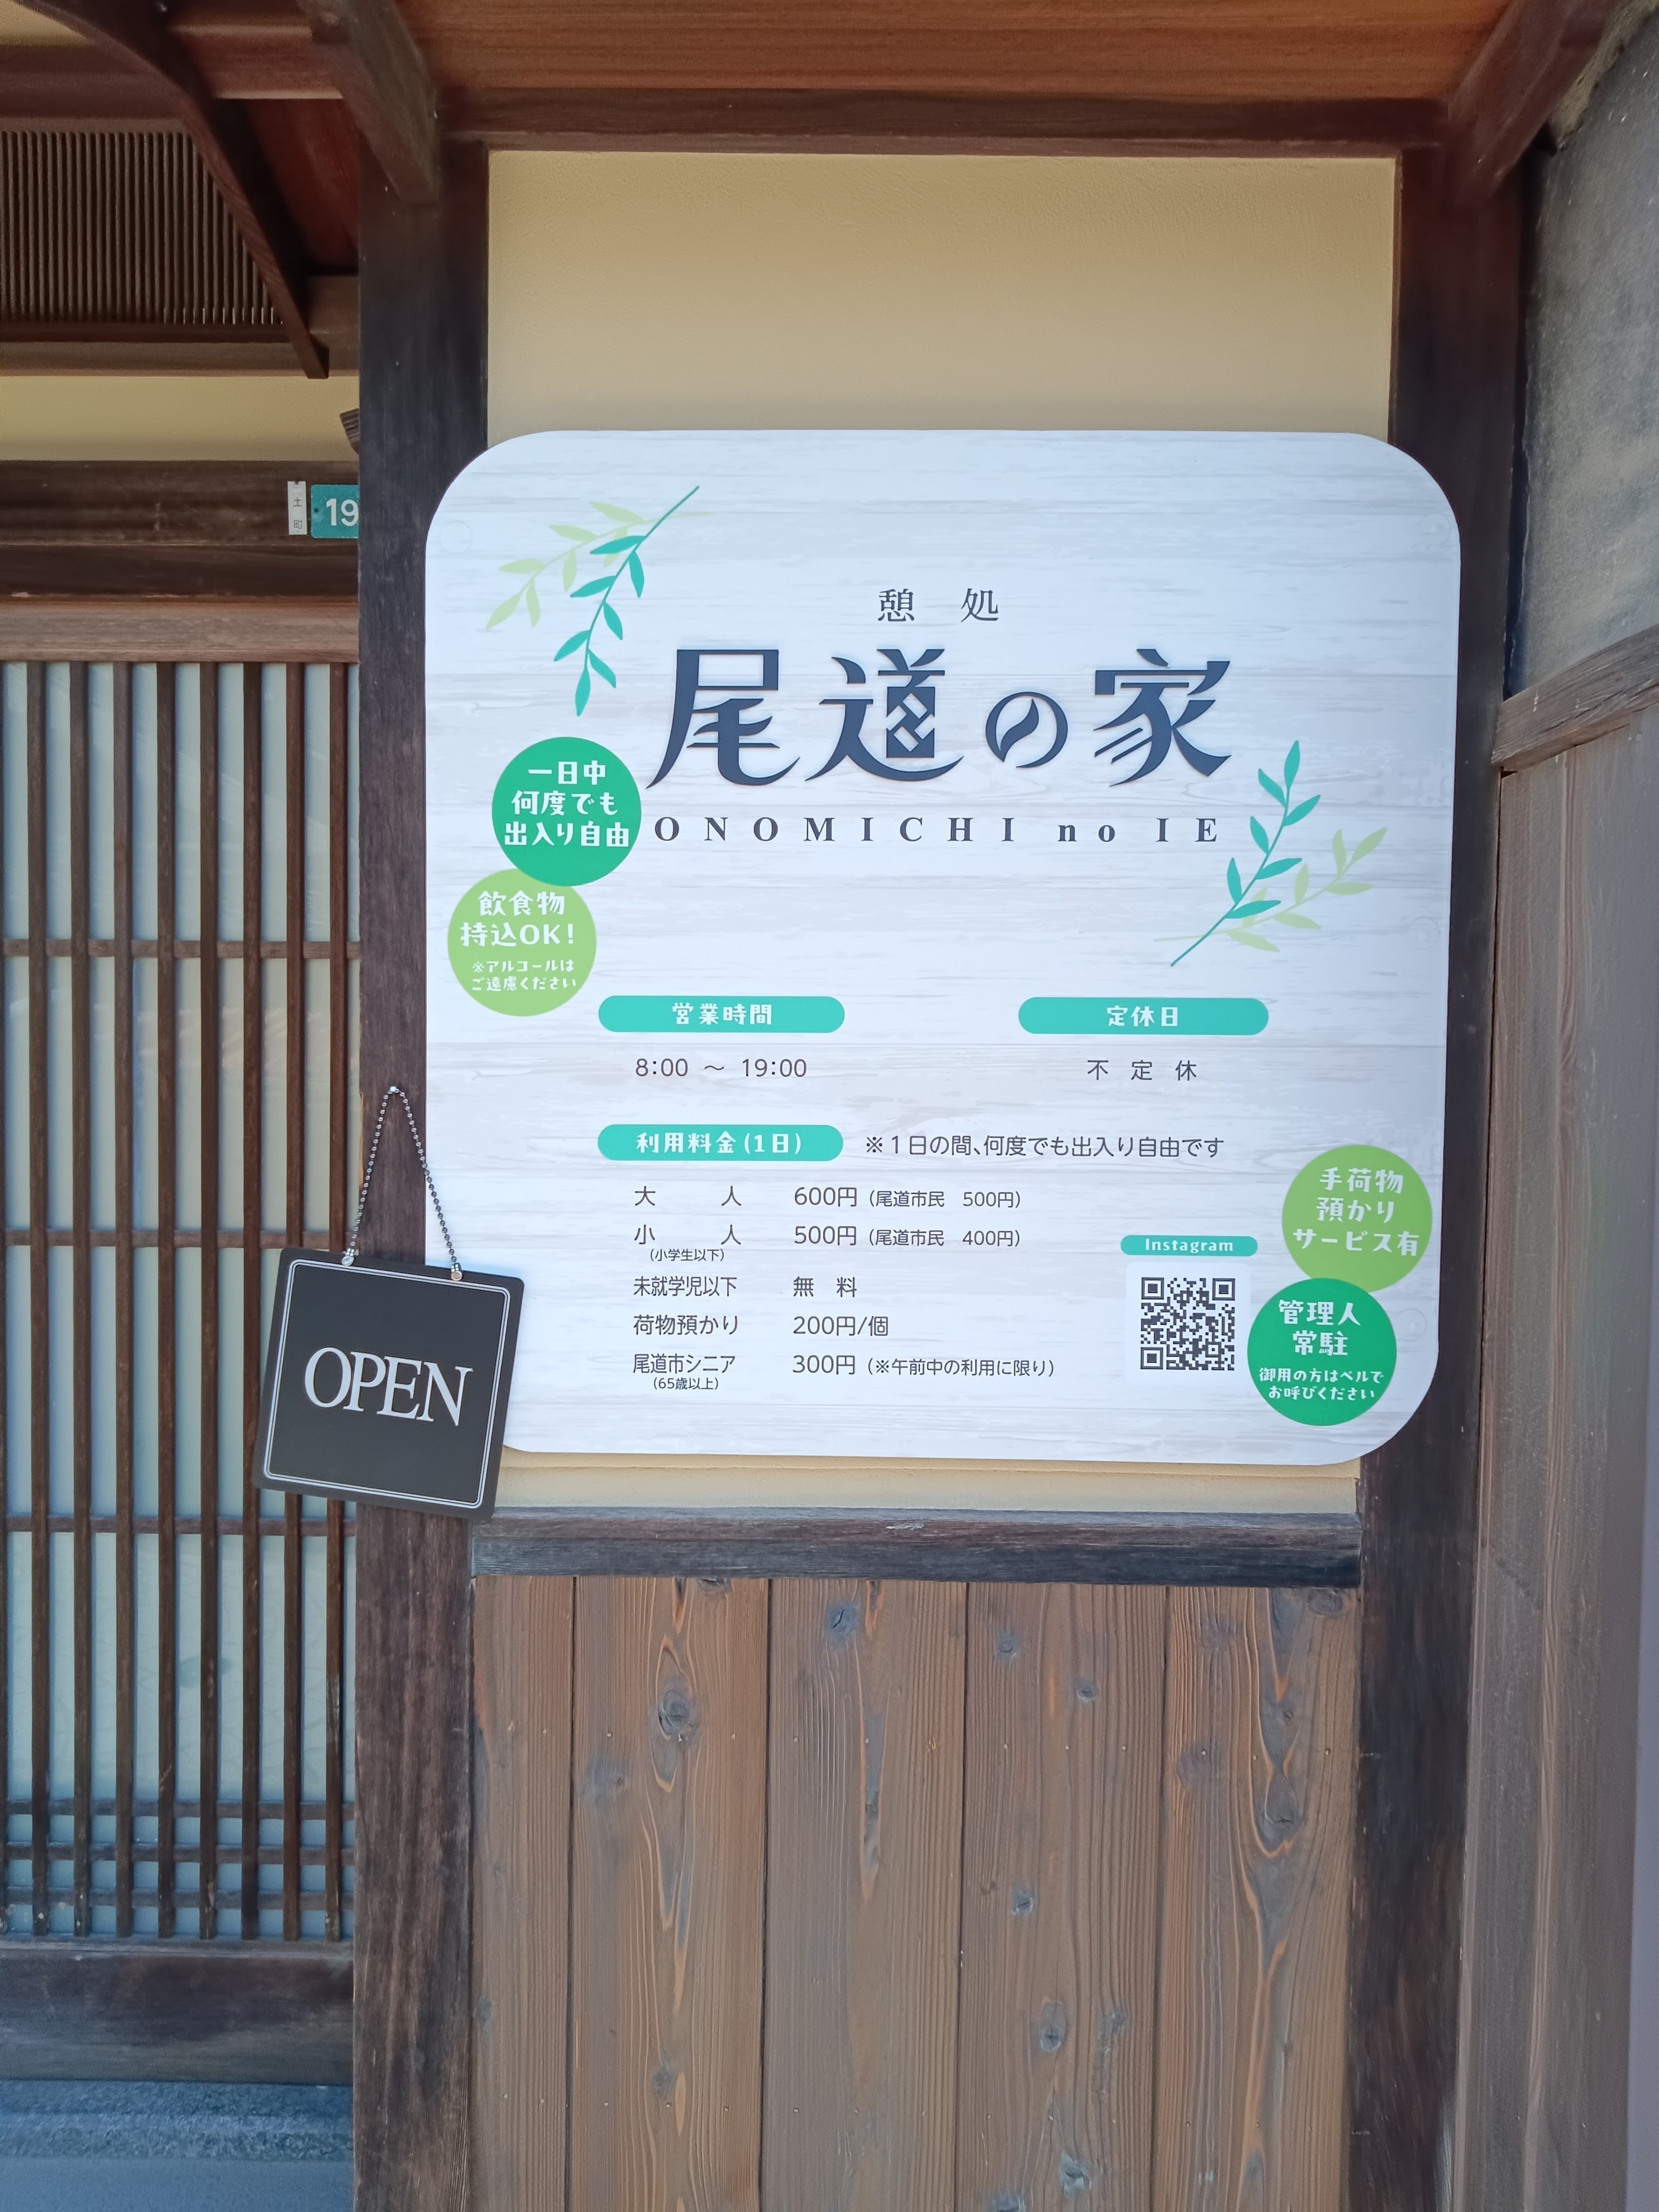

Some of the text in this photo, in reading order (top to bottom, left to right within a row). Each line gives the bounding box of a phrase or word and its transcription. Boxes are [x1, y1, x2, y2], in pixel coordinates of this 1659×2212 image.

[326, 498, 359, 527] 19
[645, 648, 1232, 789] 尾道の家
[528, 760, 606, 785] 一日中
[511, 790, 618, 816] 何度でも
[504, 820, 629, 847] 出入り自由
[655, 817, 1217, 842] ONOMICHI no IE
[478, 890, 565, 916] 飲食物
[460, 922, 574, 947] 持込OK!
[471, 976, 577, 992] ご遠慮ください
[672, 1002, 772, 1025] 営業時間
[1107, 1005, 1178, 1027] 定休日
[636, 1058, 688, 1077] 8:00
[742, 1058, 807, 1077] 19:00
[637, 1131, 801, 1155] 利用料金(1日)
[1319, 1166, 1404, 1194] 手荷物
[794, 1186, 857, 1207] 600円
[1316, 1197, 1394, 1223] 預かり
[794, 1225, 857, 1246] 500円
[1145, 1238, 1234, 1253] Instagram
[1292, 1228, 1420, 1257] サービス有
[650, 1249, 724, 1262] (小学生以下)
[633, 1276, 737, 1297] 未就学児以下
[1278, 1299, 1360, 1325] 管理人
[633, 1314, 888, 1337] 荷物預かり 200円/個
[1292, 1330, 1348, 1356] 常駐
[633, 1353, 736, 1374] 尾道市シニア
[792, 1355, 855, 1375] 300円
[1259, 1367, 1385, 1384] 御用の方はベルで
[305, 1347, 474, 1426] OPEN
[653, 1377, 718, 1390] (65歳以上)
[1268, 1386, 1375, 1401] お呼びください
